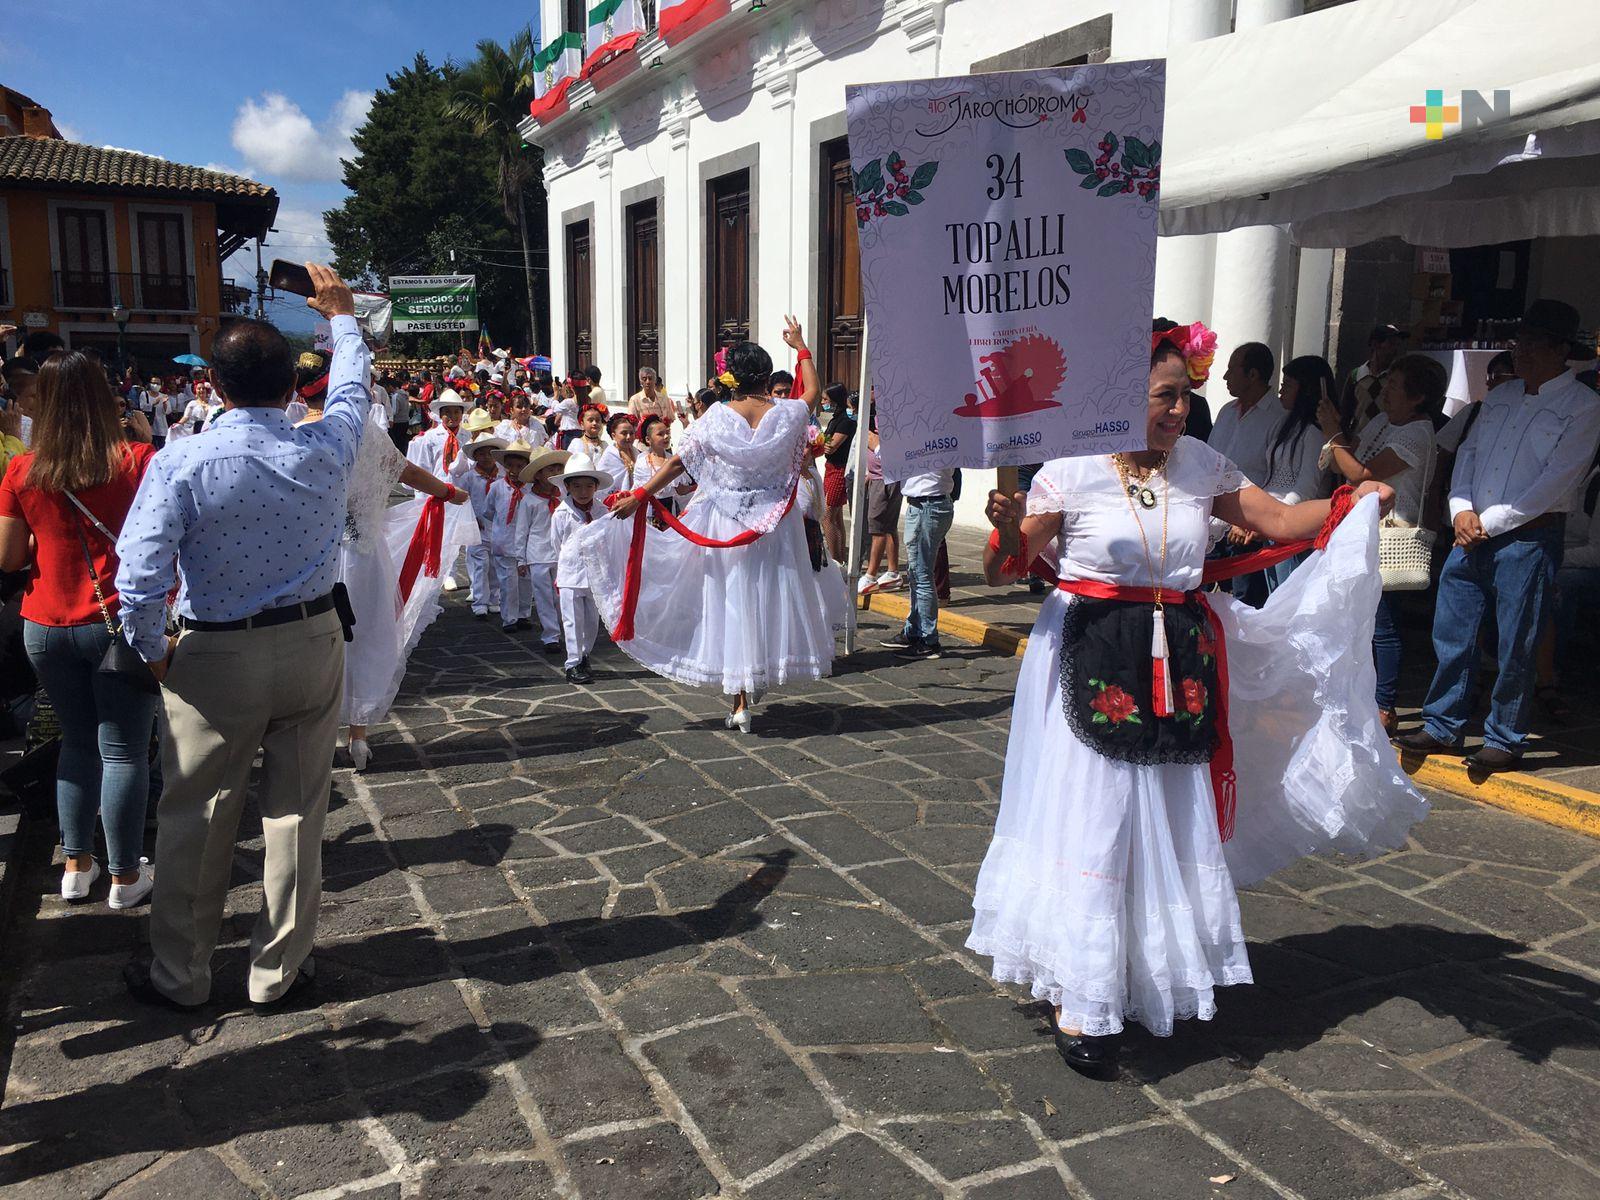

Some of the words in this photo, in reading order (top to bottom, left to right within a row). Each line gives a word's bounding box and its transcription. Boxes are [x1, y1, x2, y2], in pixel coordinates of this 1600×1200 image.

[986, 152, 1024, 201] 34
[945, 214, 1065, 264] TOPALLI
[398, 295, 454, 303] COMERCIOS
[456, 294, 469, 302] EN
[942, 264, 1071, 315] MORELOS
[408, 305, 463, 314] SERVICIO
[434, 321, 466, 330] USTED
